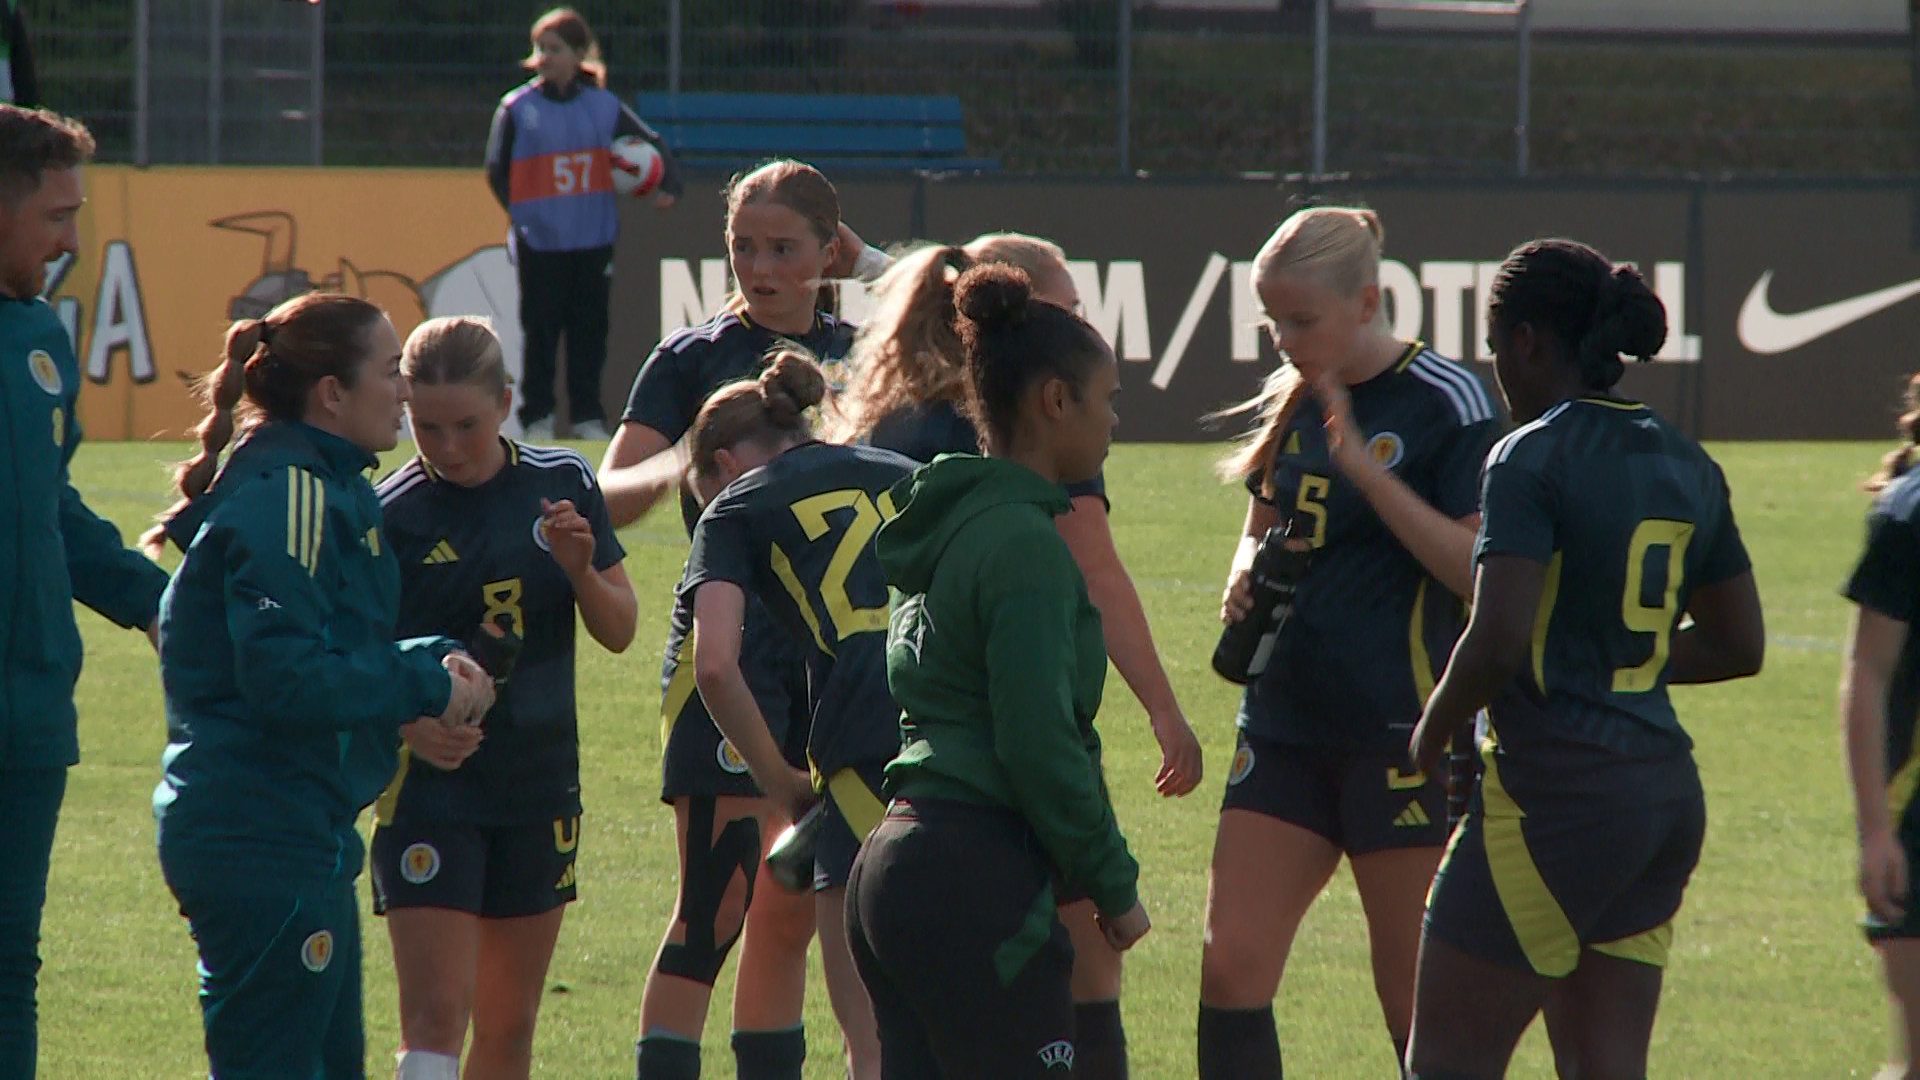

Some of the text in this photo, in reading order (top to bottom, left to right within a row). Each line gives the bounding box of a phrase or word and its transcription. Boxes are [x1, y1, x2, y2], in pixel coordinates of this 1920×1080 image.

[553, 153, 594, 193] 57
[1297, 473, 1331, 549] 5
[789, 487, 899, 642] 2
[482, 577, 524, 641] 8
[1611, 519, 1696, 693] 9
